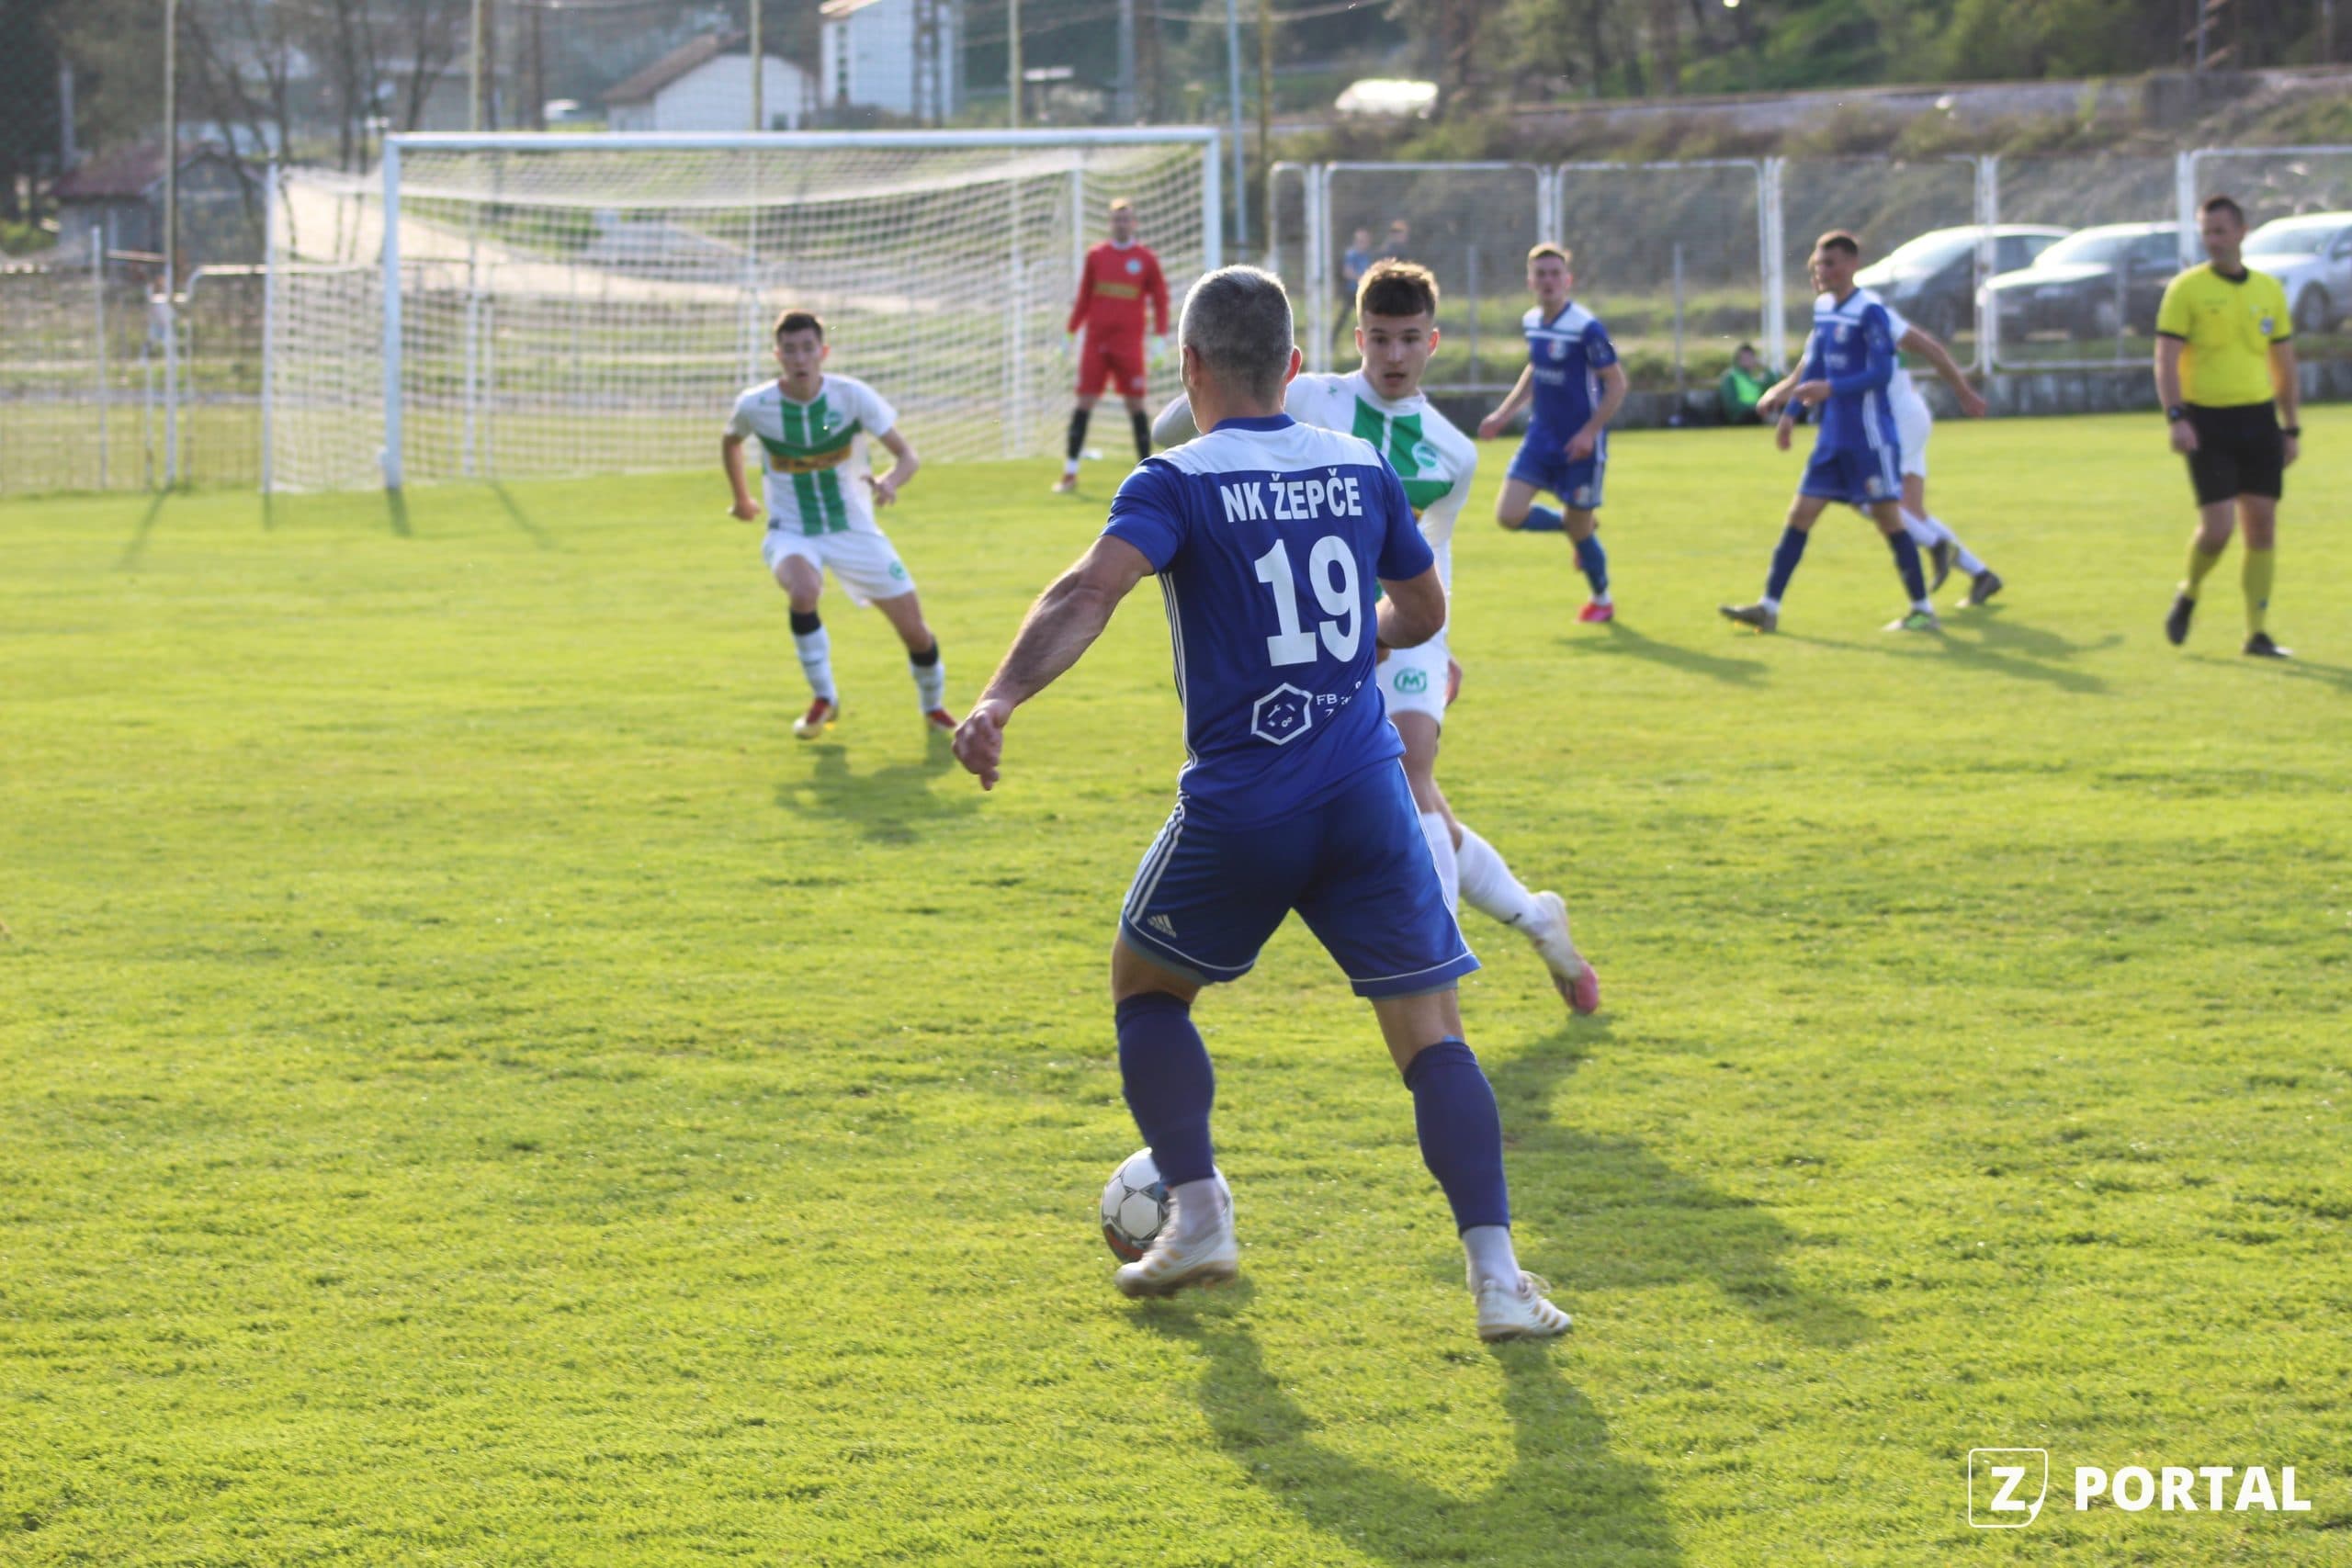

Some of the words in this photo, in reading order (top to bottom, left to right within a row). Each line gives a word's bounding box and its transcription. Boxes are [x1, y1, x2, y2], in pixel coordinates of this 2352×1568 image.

[1220, 482, 1268, 522] NK
[1271, 468, 1363, 520] ŽEPČE
[1254, 536, 1362, 666] 19
